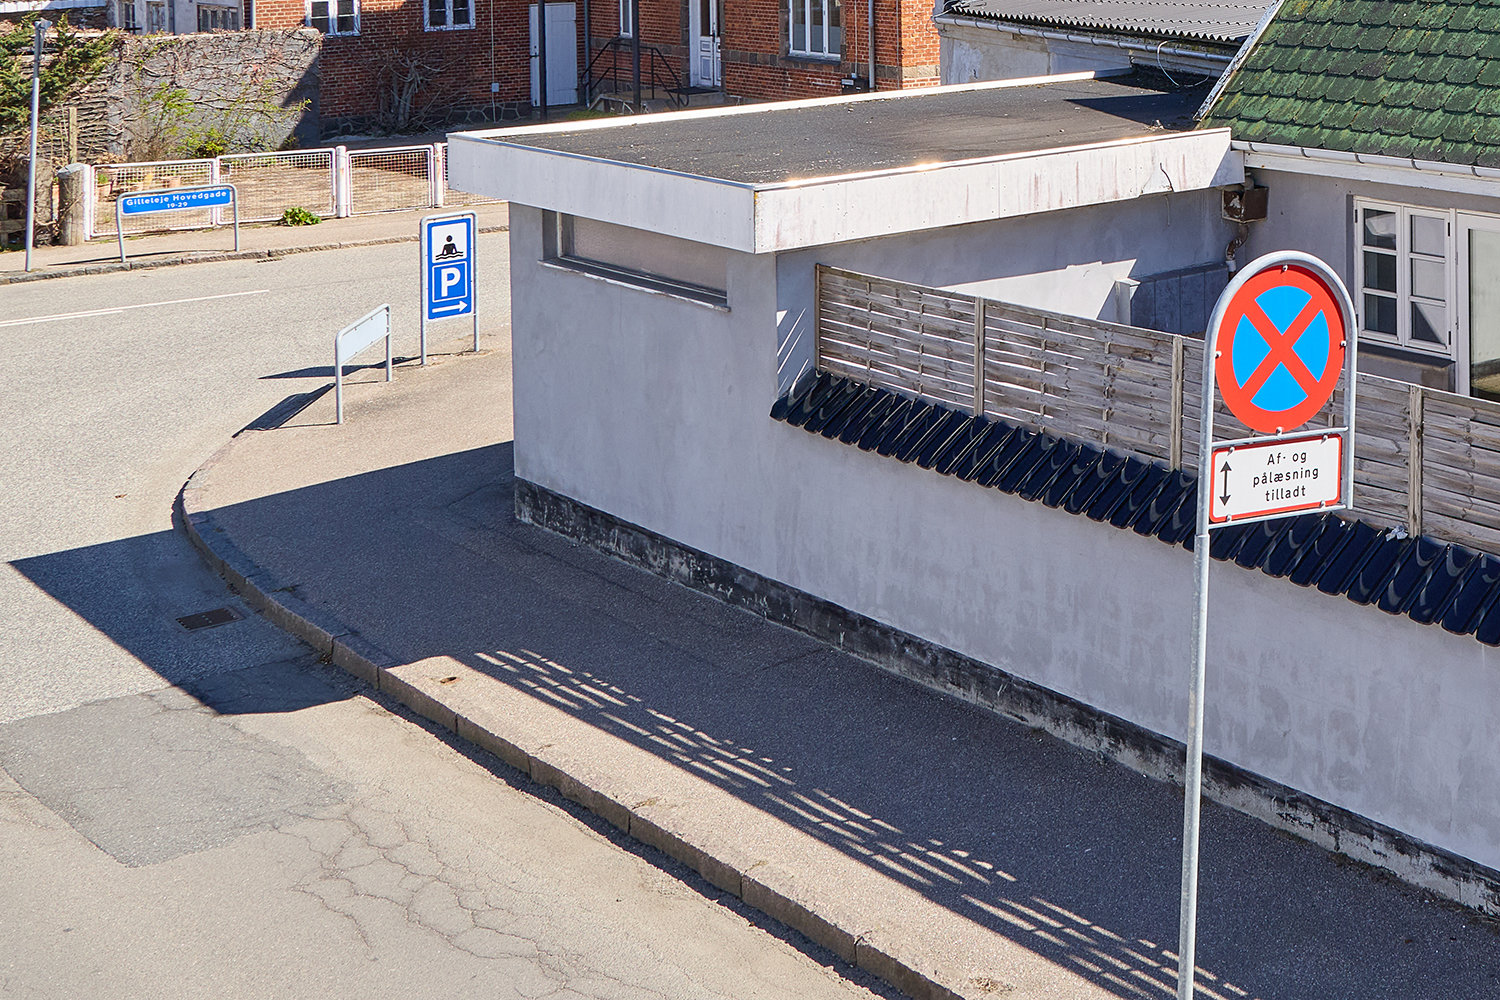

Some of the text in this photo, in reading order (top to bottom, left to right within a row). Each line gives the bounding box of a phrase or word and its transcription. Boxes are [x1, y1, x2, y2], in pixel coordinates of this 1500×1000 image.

[126, 190, 227, 206] Gilleleje Hovedgade
[167, 201, 188, 209] 19-29
[441, 267, 461, 298] P
[1266, 451, 1307, 466] Af- og
[1252, 467, 1319, 488] pålæsning
[1265, 485, 1306, 502] tilladt
